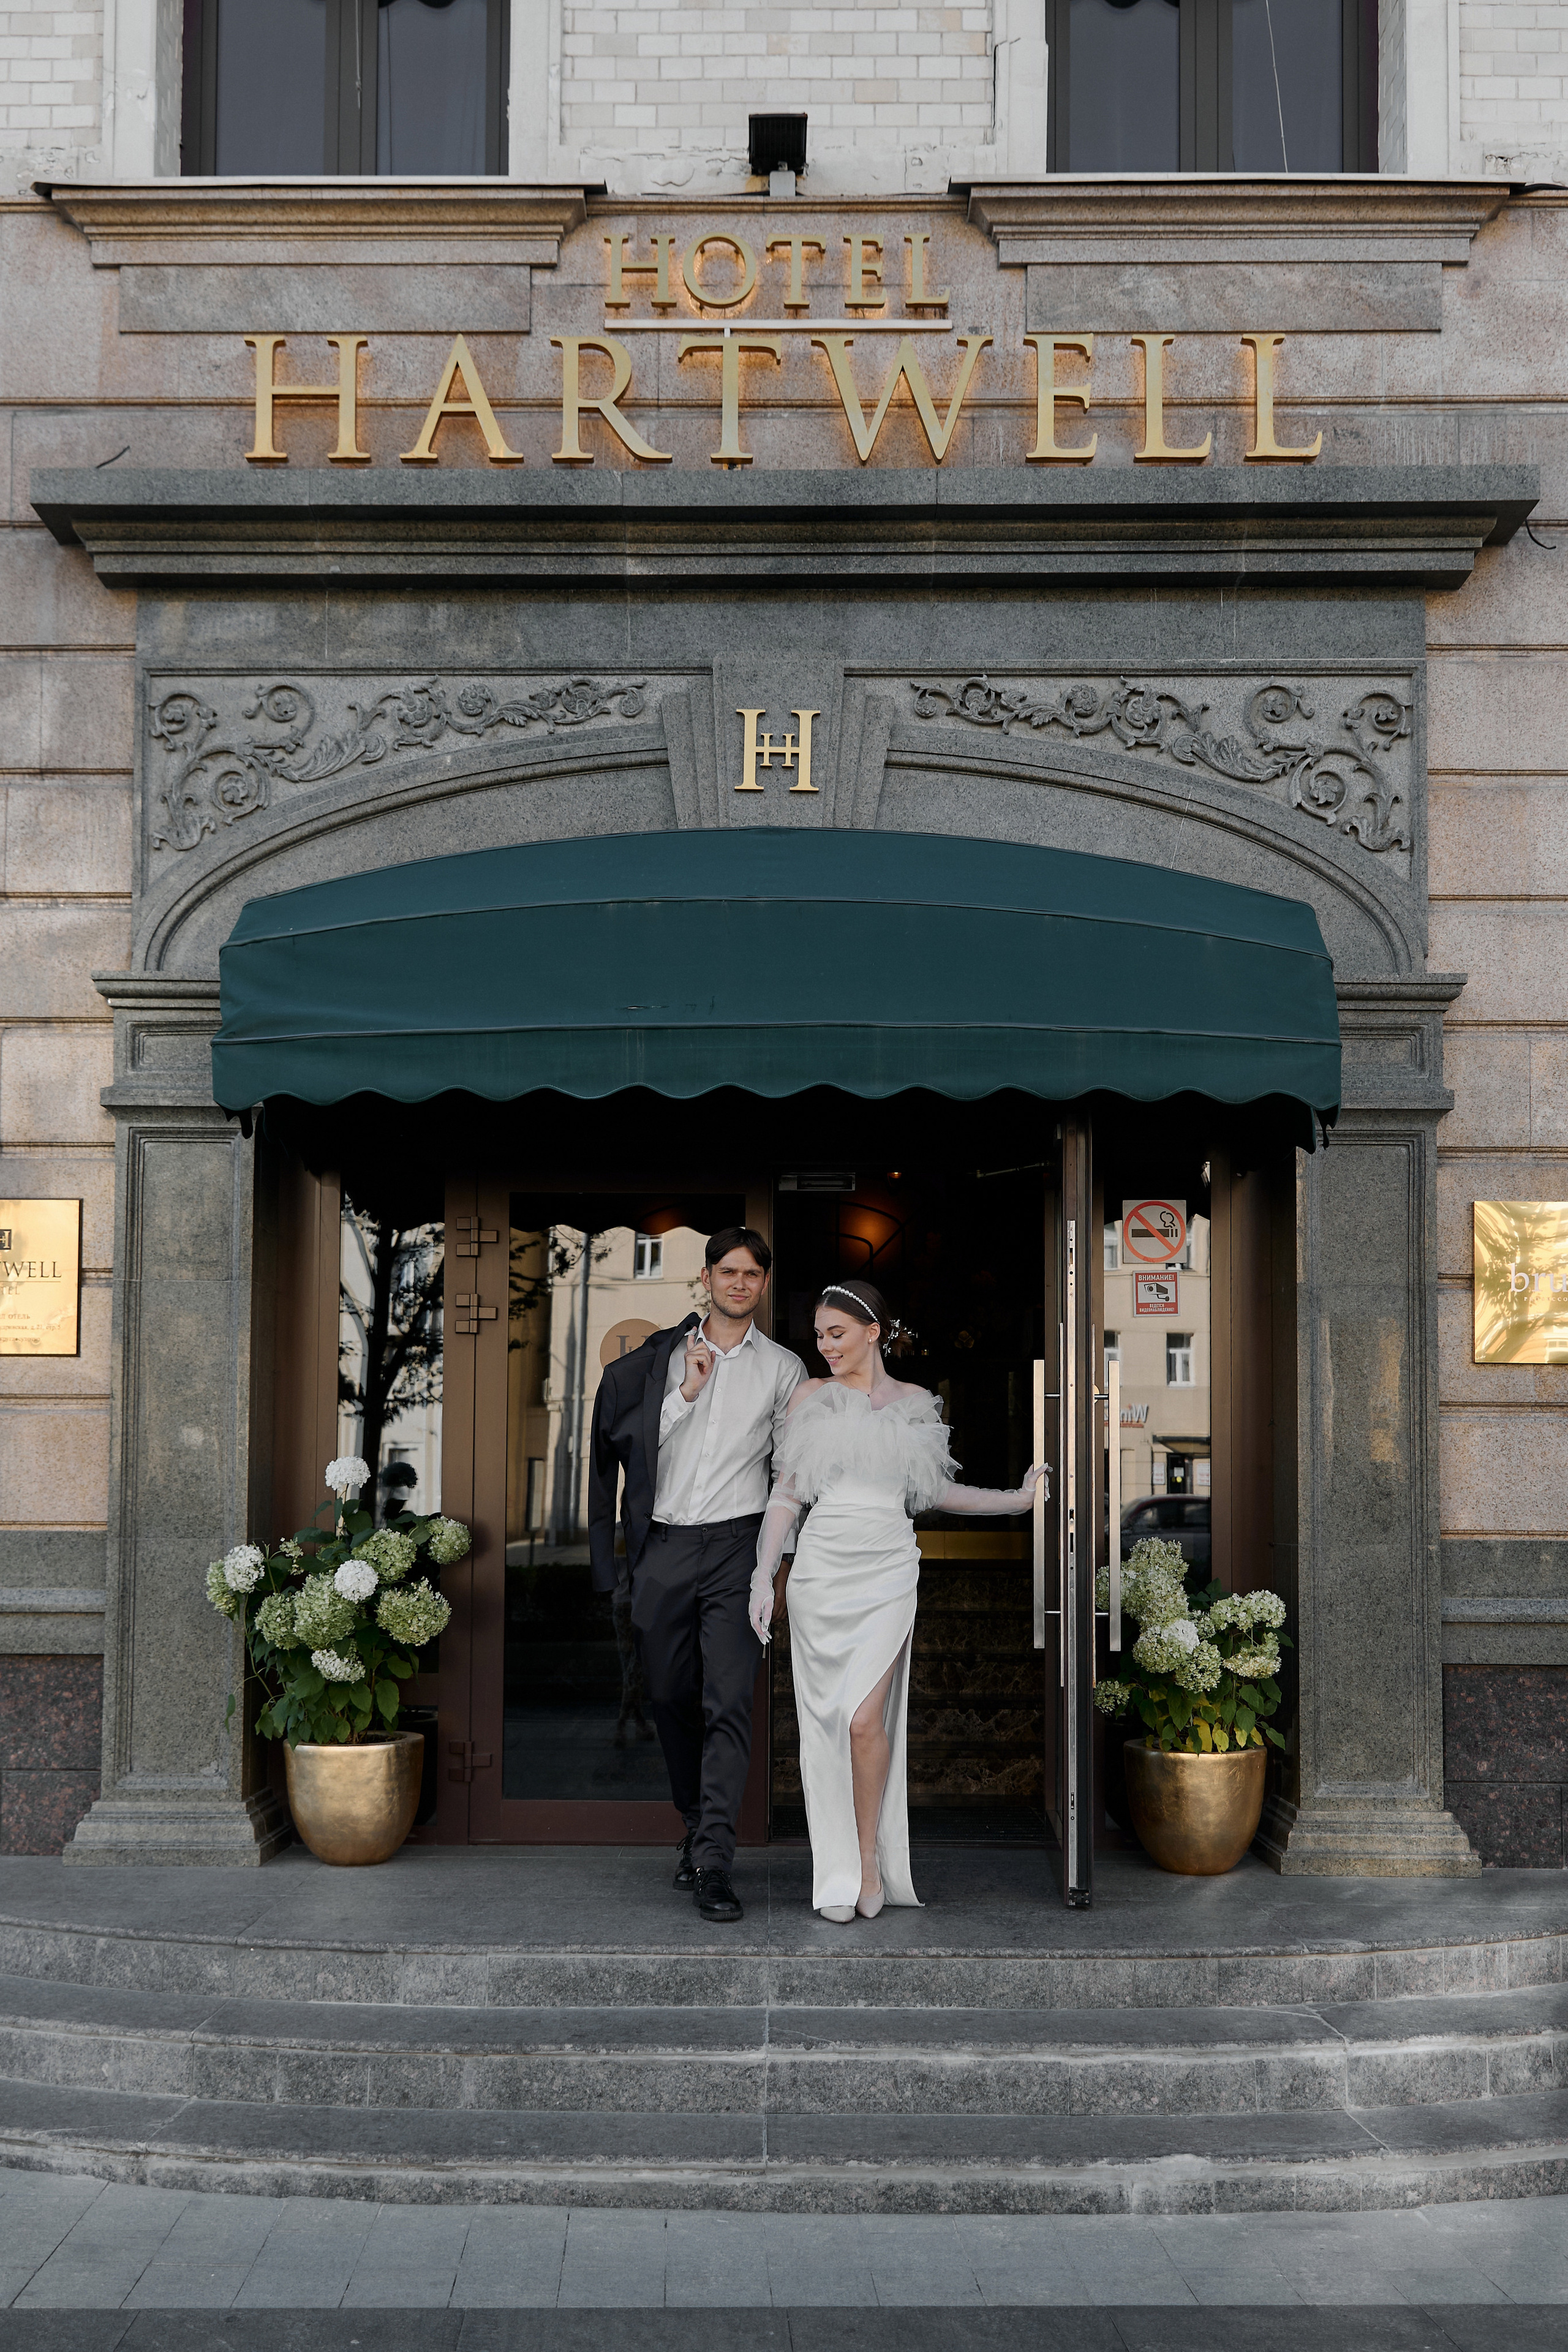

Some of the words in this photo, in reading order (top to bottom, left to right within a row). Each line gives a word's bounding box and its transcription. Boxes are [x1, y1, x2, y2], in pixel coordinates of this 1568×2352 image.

[605, 233, 950, 309] HOTEL
[244, 333, 1323, 463] HARTWELL
[0, 1261, 62, 1278] WELL
[1508, 1262, 1568, 1293] bru
